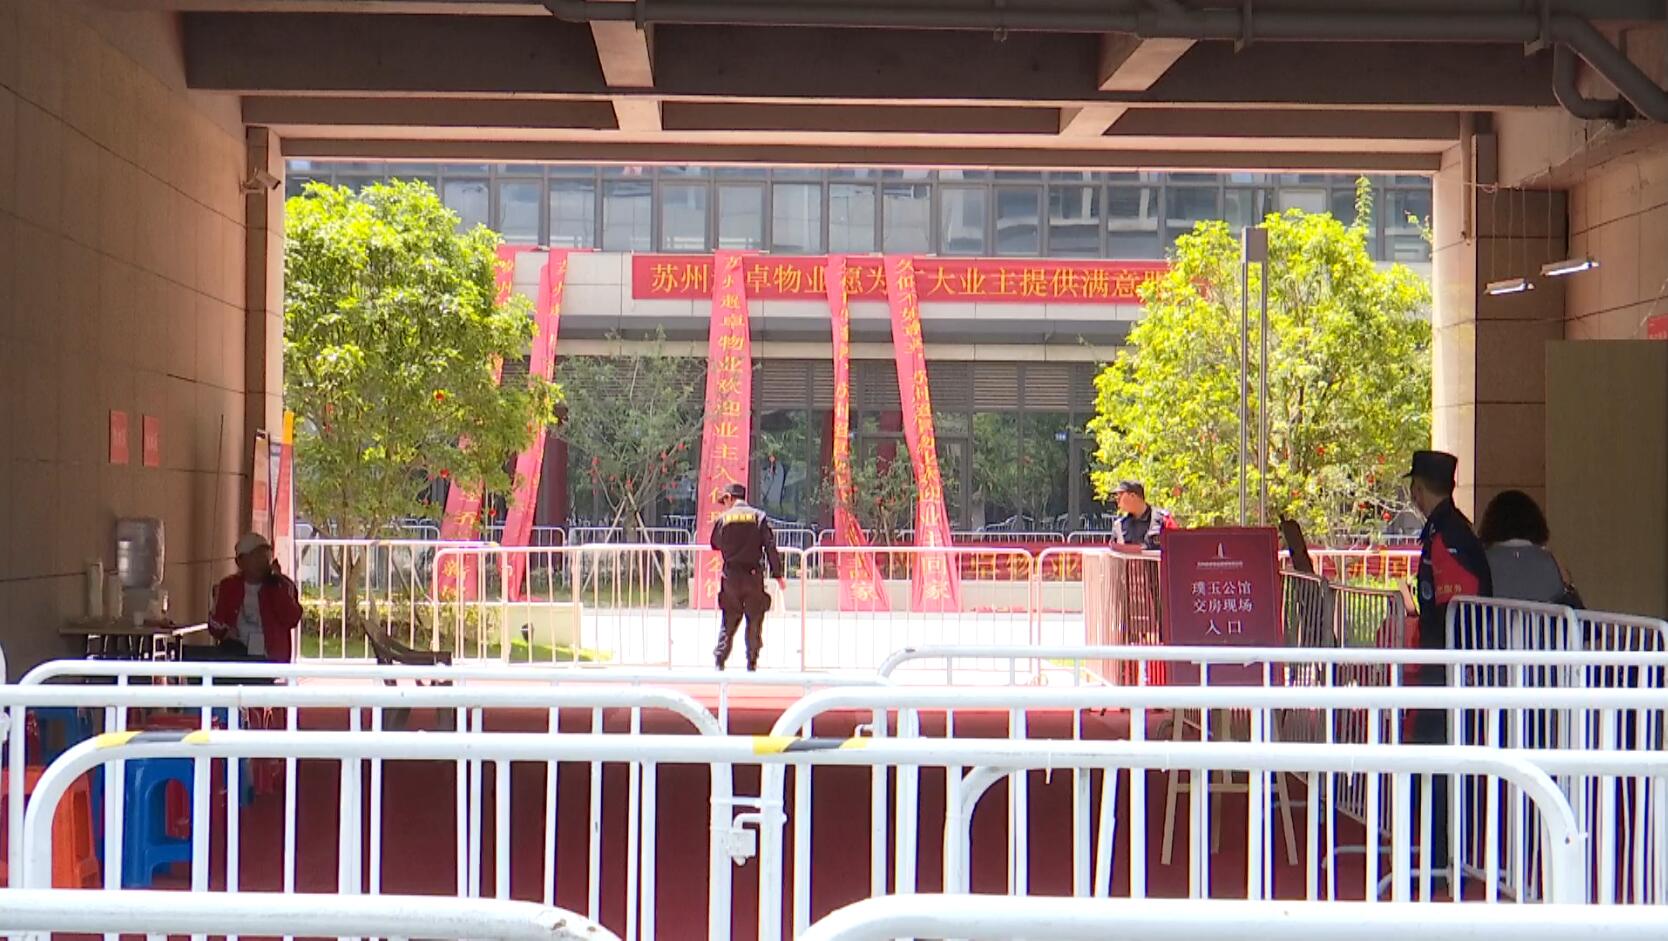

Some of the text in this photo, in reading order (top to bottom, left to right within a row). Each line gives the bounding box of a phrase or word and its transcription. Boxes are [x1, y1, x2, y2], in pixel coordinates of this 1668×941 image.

[1192, 581, 1251, 596] 璞玉公馆
[1193, 599, 1252, 614] 交房现场
